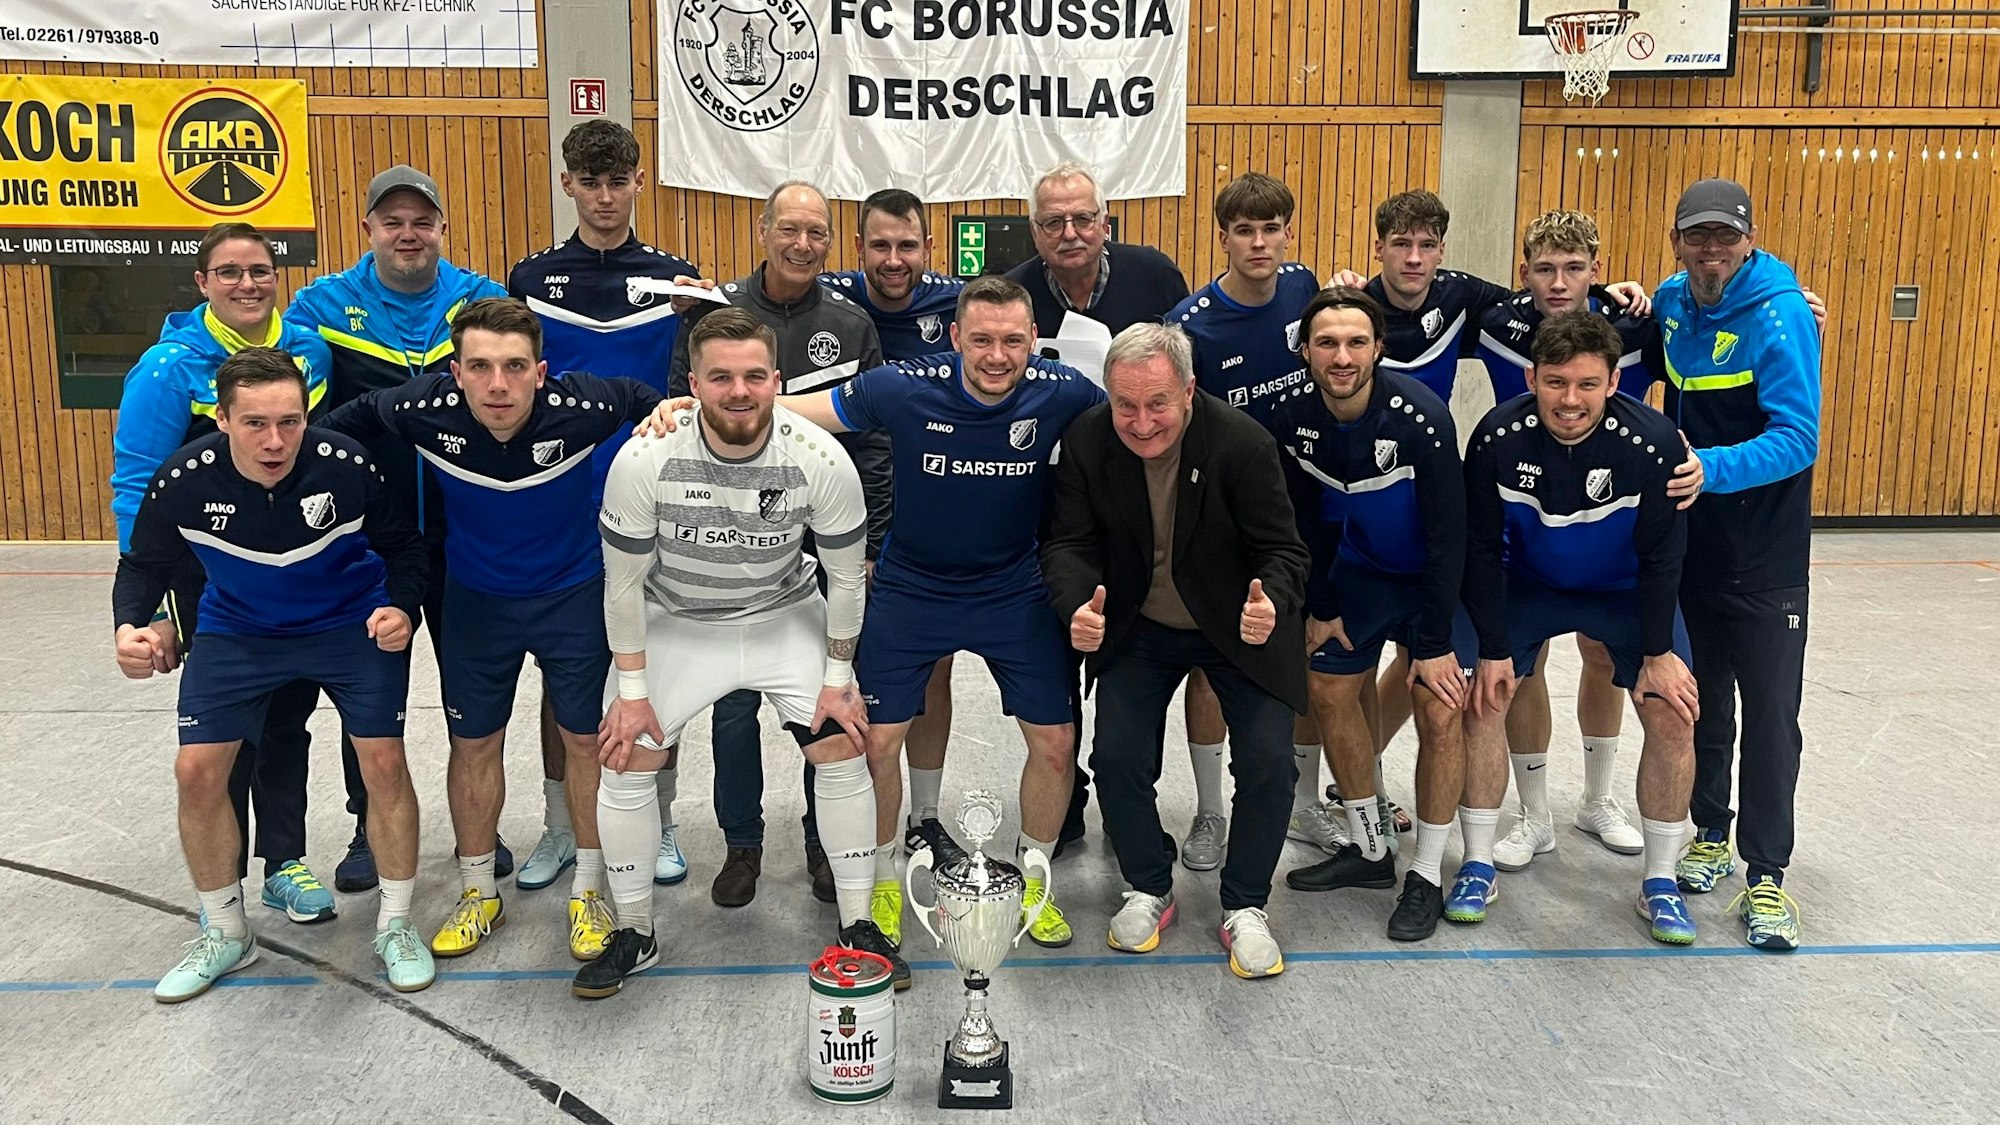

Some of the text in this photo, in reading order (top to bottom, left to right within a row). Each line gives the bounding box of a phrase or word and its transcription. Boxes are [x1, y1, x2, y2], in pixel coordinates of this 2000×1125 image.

[831, 0, 893, 40] FC
[913, 0, 1174, 41] BORUSSIA
[678, 38, 703, 50] 1920
[786, 50, 816, 61] 2004
[1664, 53, 1721, 64] FRATUFA
[689, 72, 806, 126] DERSCHLAG
[848, 73, 1155, 121] DERSCHLAG
[180, 120, 265, 150] AKA
[59, 179, 139, 208] GMBH
[22, 238, 53, 253] UND
[55, 238, 150, 256] LEITUNGSBAU
[545, 275, 570, 284] JAKO
[549, 285, 564, 299] 26
[349, 316, 365, 332] BK
[1506, 319, 1530, 333] JAKO
[1221, 355, 1244, 370] JAKO
[1251, 368, 1307, 399] SARSTEDT
[925, 421, 955, 434] JAKO
[1295, 427, 1320, 440] JAKO
[436, 432, 467, 446] JAKO
[443, 441, 461, 455] 20
[1302, 441, 1313, 455] 21
[951, 460, 1037, 476] SARSTEDT
[1516, 462, 1543, 476] JAKO
[1519, 474, 1536, 489] 23
[685, 489, 712, 500] JAKO
[203, 502, 236, 514] JAKO
[210, 515, 228, 531] 27
[705, 529, 791, 547] SARSTEDT
[1787, 614, 1800, 629] TR
[844, 850, 876, 859] JAKO
[819, 1029, 880, 1065] Zunft
[833, 1063, 875, 1078] KÖLSCH
